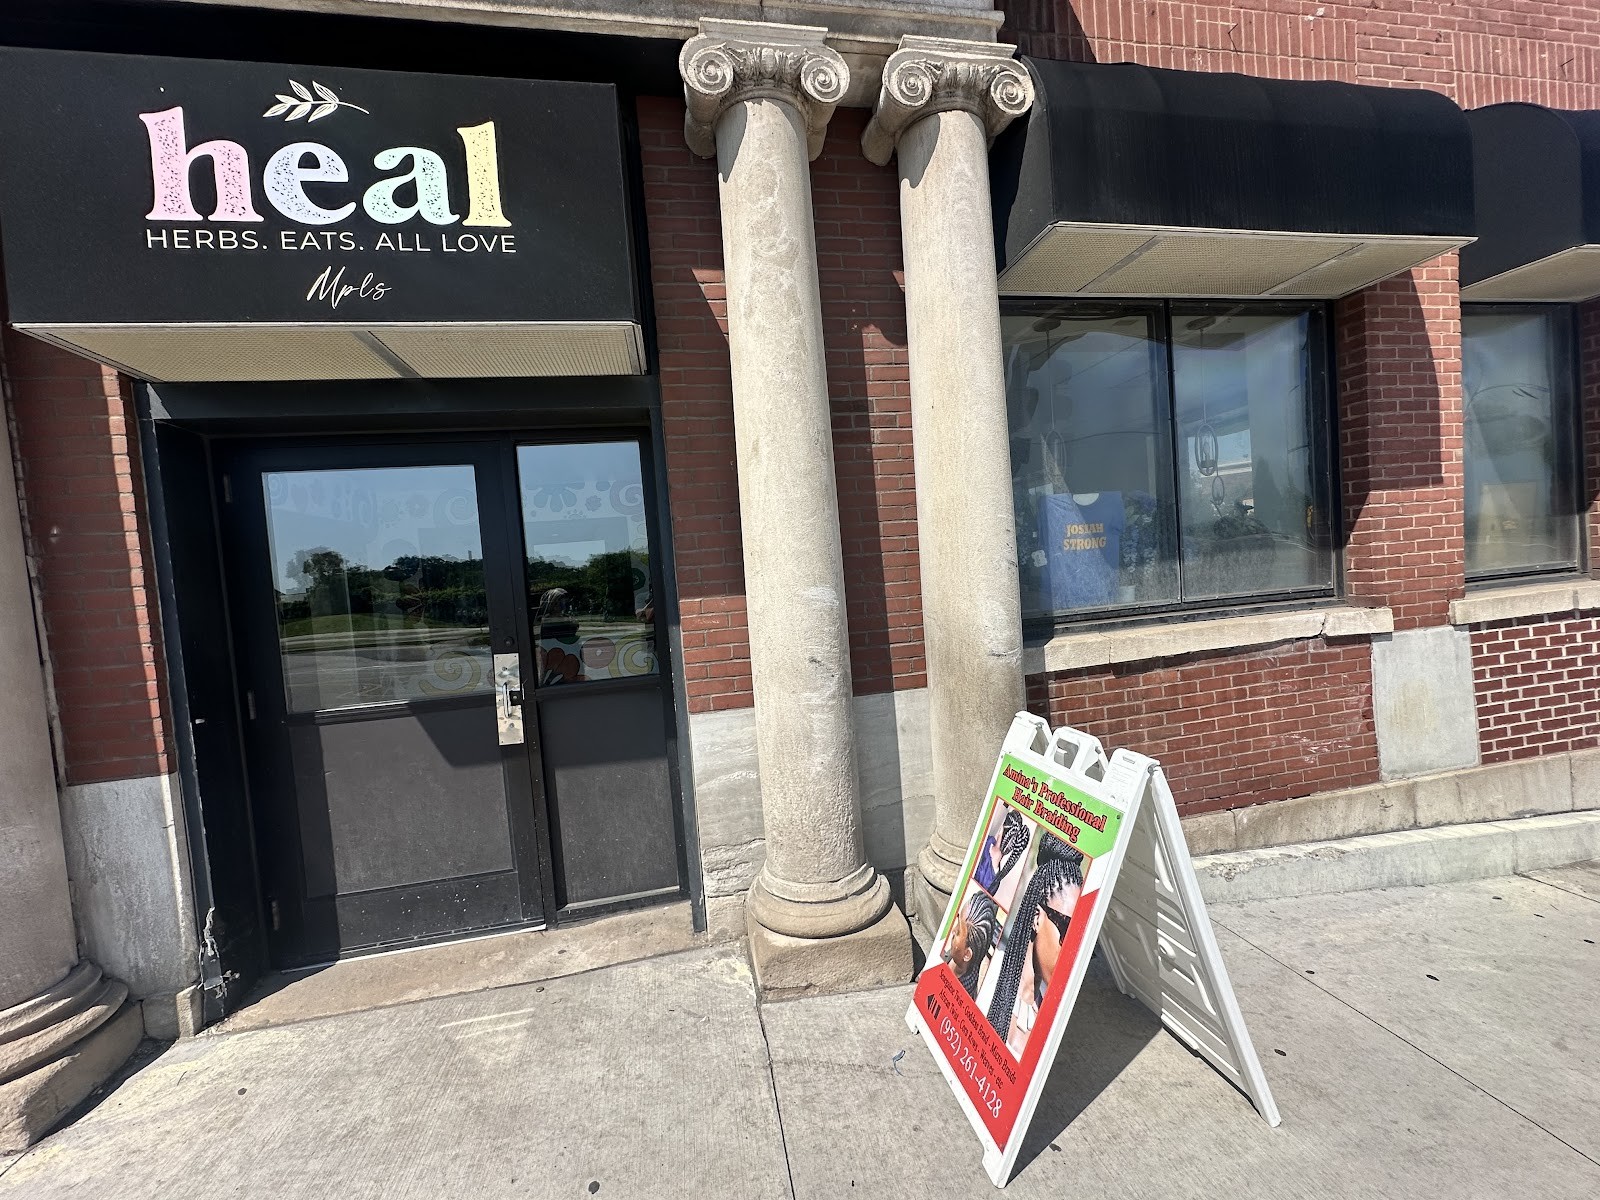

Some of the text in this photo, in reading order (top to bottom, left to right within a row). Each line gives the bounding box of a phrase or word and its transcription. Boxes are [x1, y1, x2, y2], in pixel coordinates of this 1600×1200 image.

[138, 105, 512, 228] heal
[145, 228, 517, 254] HERBS. EATS. ALL LOVE
[306, 265, 392, 310] Mpls
[1063, 537, 1106, 551] STRONG
[1065, 523, 1104, 537] JOSIAH
[1003, 763, 1039, 794] Amina's
[1038, 781, 1108, 834] Professional
[1011, 786, 1081, 843] Hair Braiding
[940, 1016, 1003, 1119] (952) 261-4128
[980, 1048, 995, 1076] Weaves
[990, 1041, 1003, 1066] Micro
[1001, 1058, 1017, 1085] Braids
